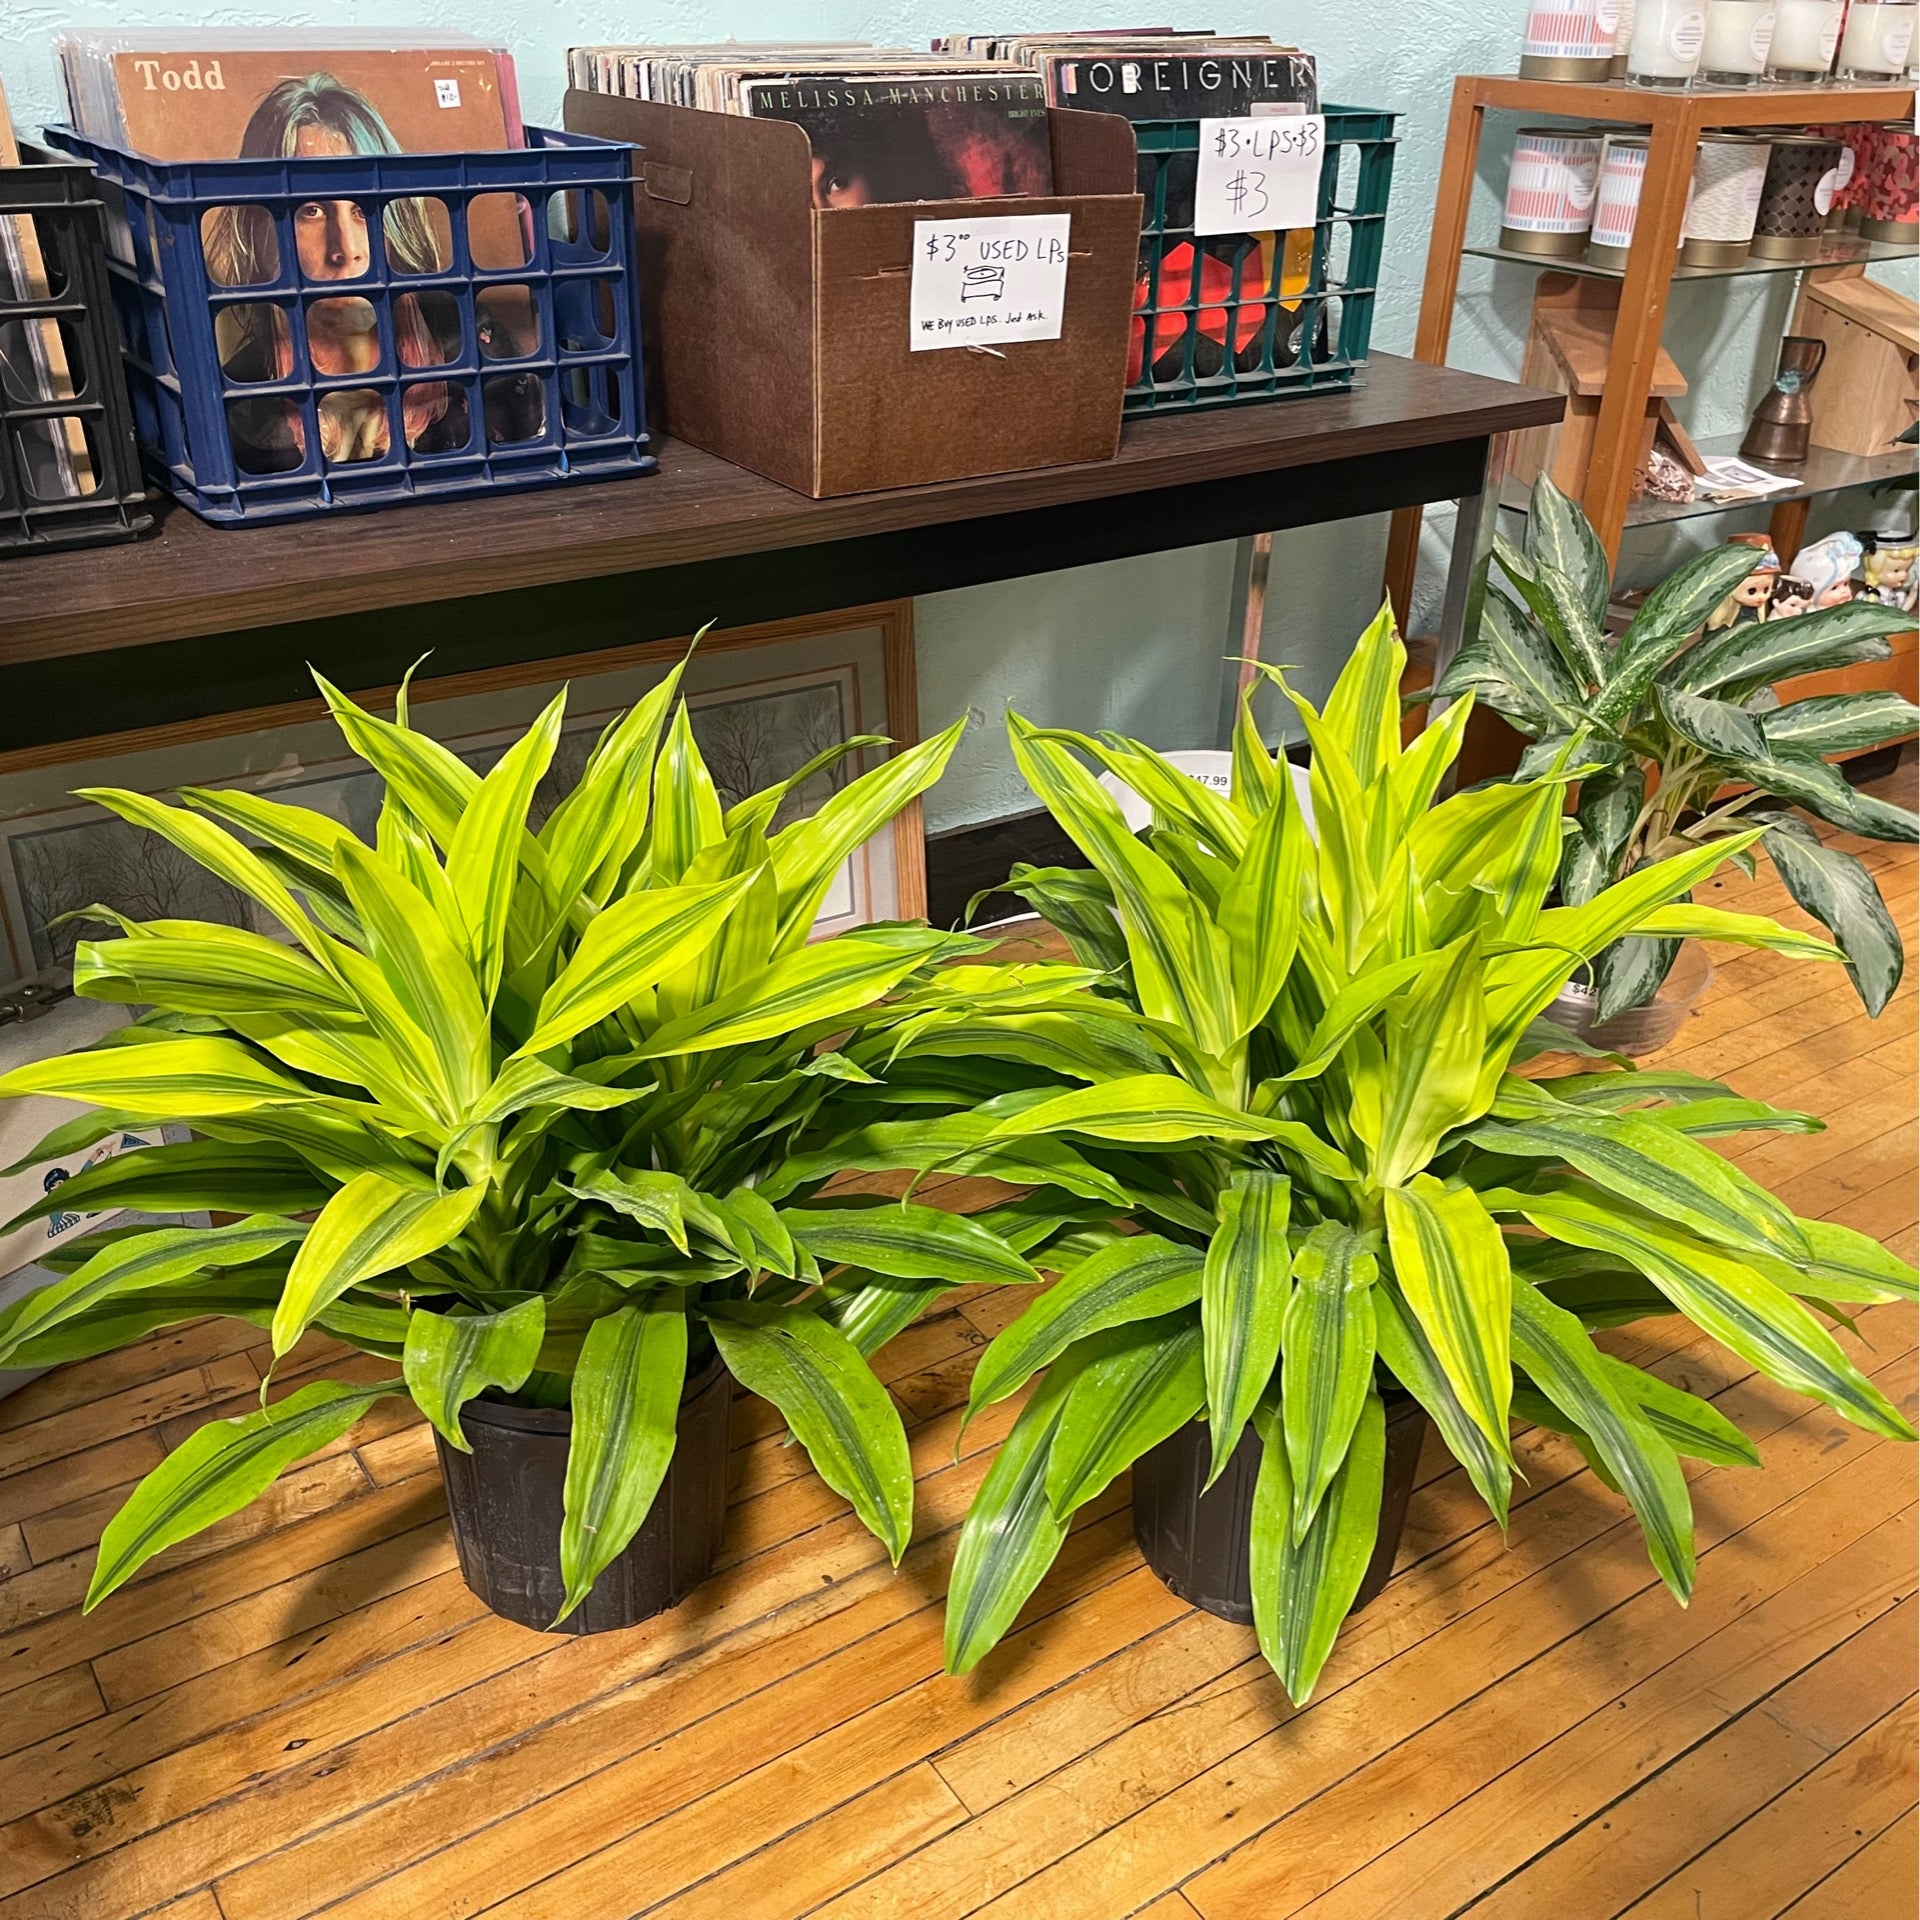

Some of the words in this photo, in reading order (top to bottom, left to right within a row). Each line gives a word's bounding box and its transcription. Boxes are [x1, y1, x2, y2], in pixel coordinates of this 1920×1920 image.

[134, 60, 226, 91] Todd
[760, 89, 873, 109] MELISSA
[889, 83, 1044, 104] MANCHESTER
[1225, 169, 1268, 217] $3
[980, 239, 1029, 261] USED
[921, 320, 935, 331] WE
[955, 316, 977, 328] USED
[1189, 774, 1228, 787] 47.99
